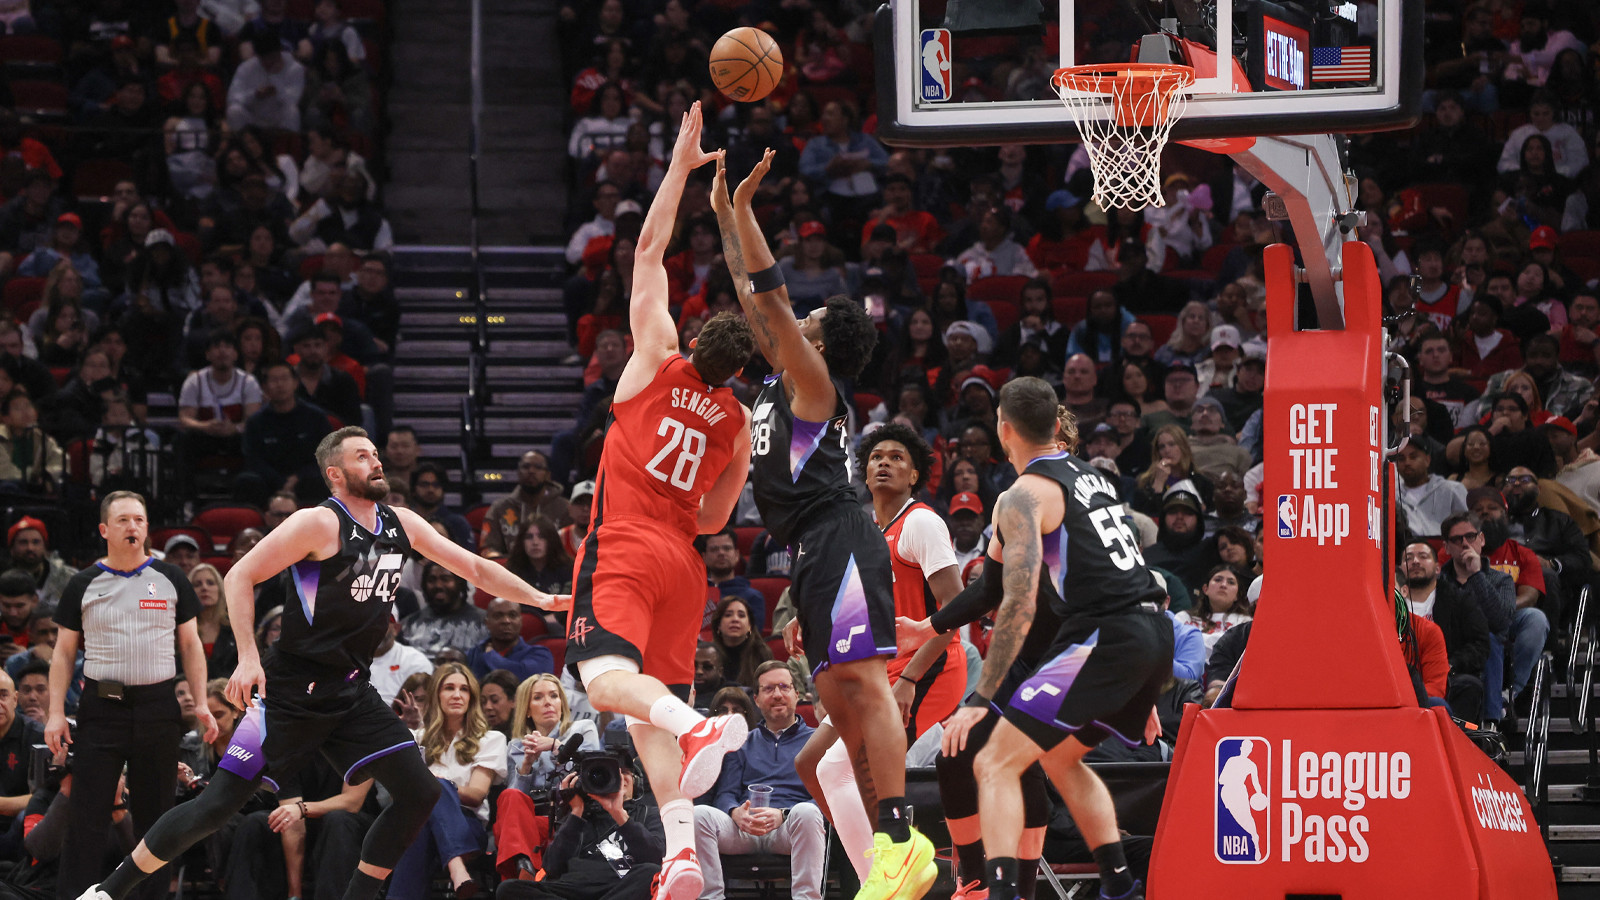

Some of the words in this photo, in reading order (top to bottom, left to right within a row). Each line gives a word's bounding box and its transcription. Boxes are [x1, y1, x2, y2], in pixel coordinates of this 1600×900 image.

[1267, 29, 1278, 78] GET
[1278, 33, 1289, 82] THE
[924, 85, 940, 97] NBA
[671, 387, 728, 427] SENGUN
[1289, 403, 1338, 445] GET
[644, 416, 707, 492] 28
[1288, 448, 1338, 490] THE
[1087, 504, 1146, 571] 55
[1300, 494, 1350, 546] App
[139, 601, 167, 609] Emirates
[374, 572, 402, 603] 42
[226, 744, 255, 762] UTAH
[1281, 739, 1411, 811] League
[1471, 772, 1528, 833] coinbase
[1222, 835, 1249, 856] NBA
[1281, 802, 1370, 863] Pass
